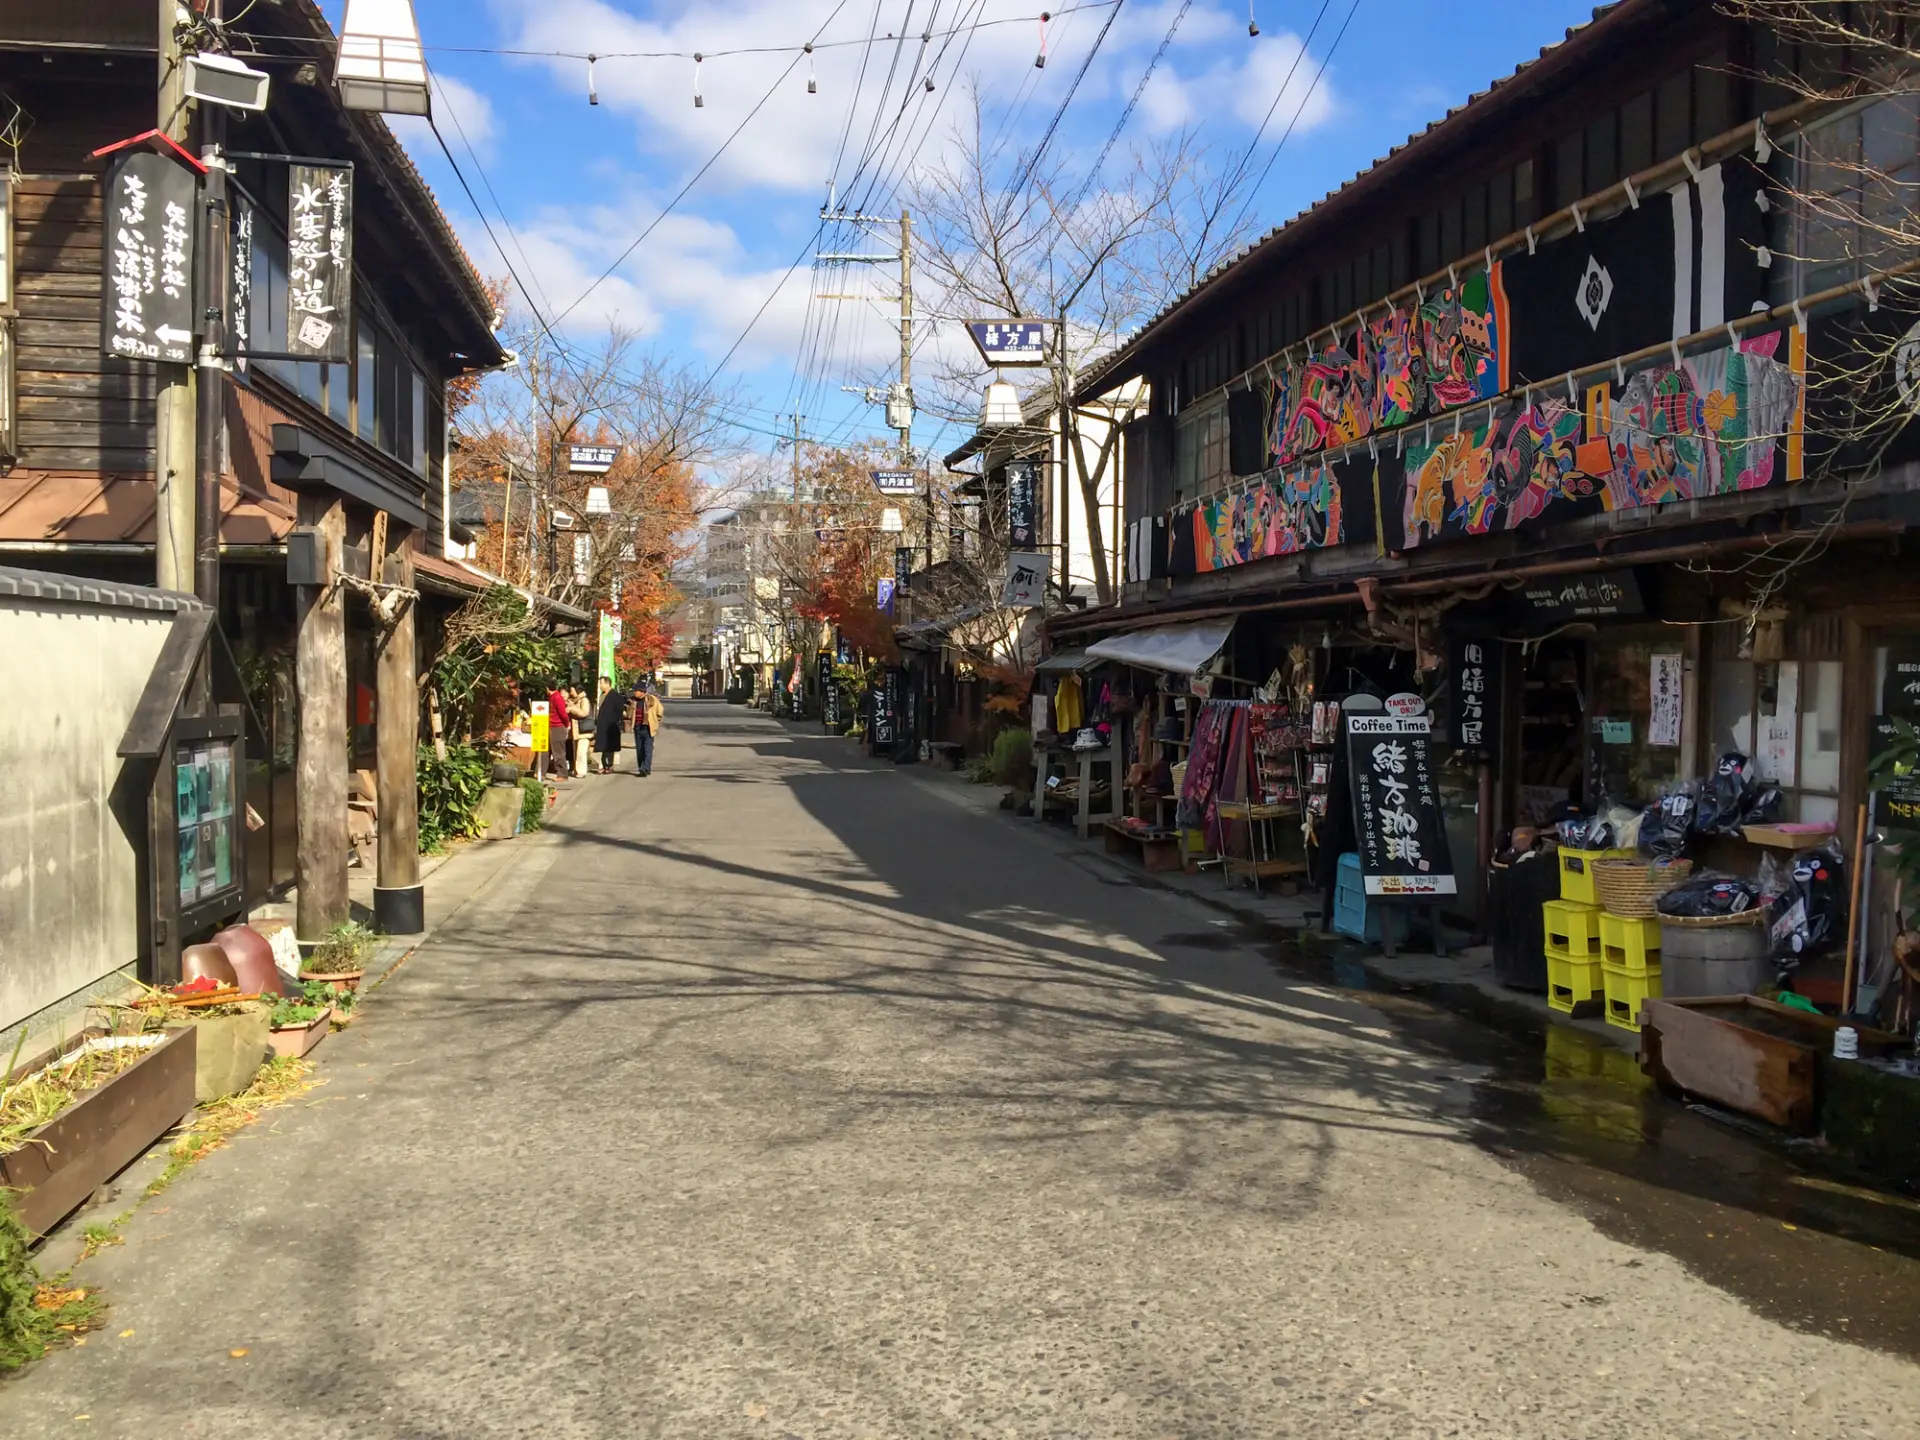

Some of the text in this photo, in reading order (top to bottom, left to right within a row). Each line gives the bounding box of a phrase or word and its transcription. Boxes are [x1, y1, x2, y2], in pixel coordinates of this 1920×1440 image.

[289, 182, 335, 314] 水基巡りの道
[985, 331, 1042, 346] 緒方屋
[821, 656, 830, 683] たんば
[1387, 697, 1421, 707] TAKE OUT
[1462, 643, 1485, 744] 旧緒方屋
[873, 689, 887, 727] ラーメン
[1400, 706, 1416, 715] OK!!
[1352, 718, 1427, 732] Coffee Time
[1411, 739, 1433, 806] 喫茶&甘味処
[1371, 740, 1422, 867] 緒方珈琲
[1376, 876, 1440, 886] 水出し珈琲
